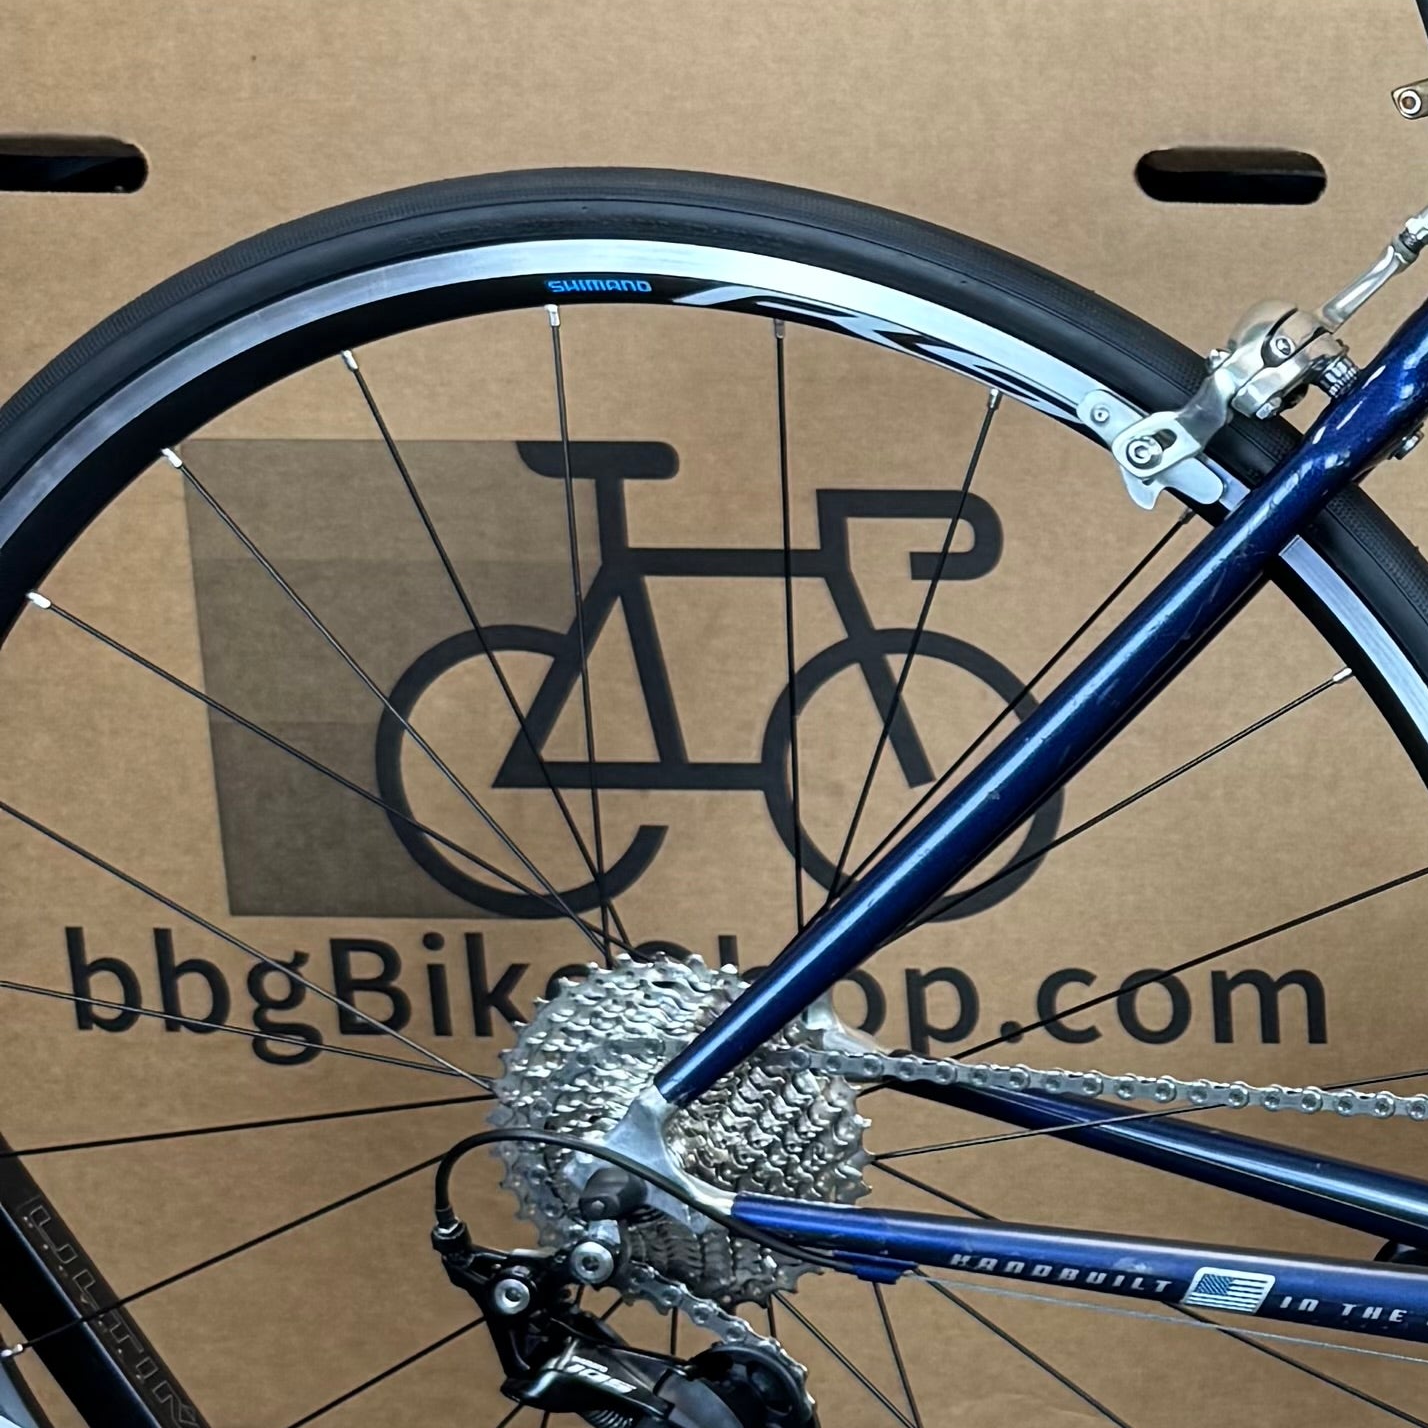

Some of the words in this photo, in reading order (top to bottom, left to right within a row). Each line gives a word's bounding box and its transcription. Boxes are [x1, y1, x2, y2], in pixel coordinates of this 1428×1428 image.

[546, 278, 652, 293] SHIMANO
[1280, 1296, 1319, 1312] IN
[1341, 1303, 1408, 1324] THE
